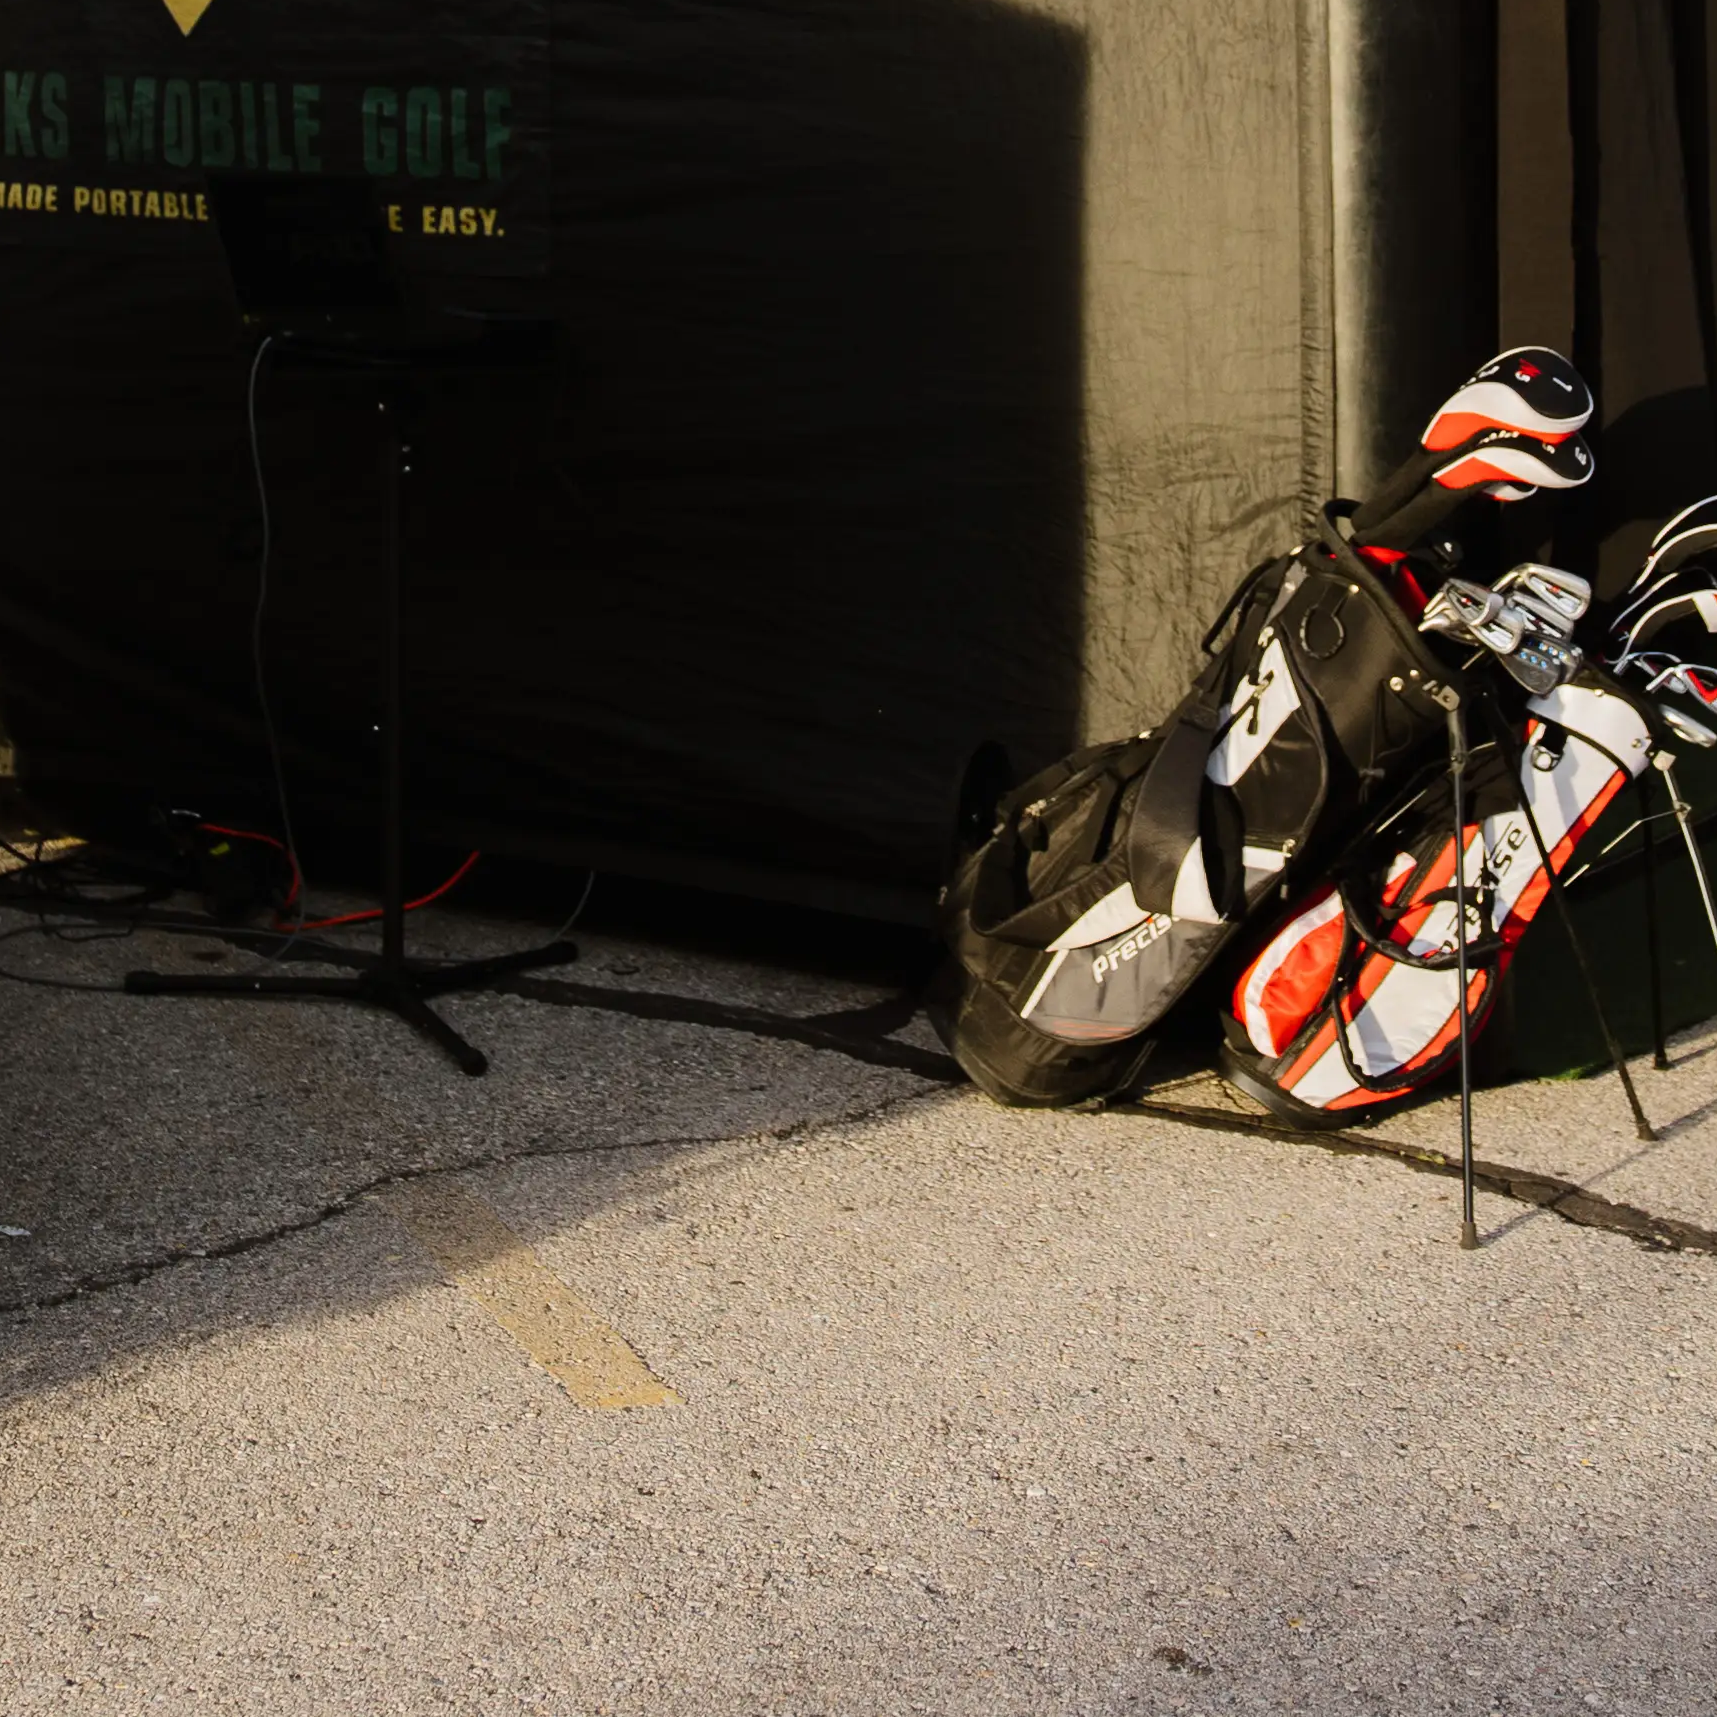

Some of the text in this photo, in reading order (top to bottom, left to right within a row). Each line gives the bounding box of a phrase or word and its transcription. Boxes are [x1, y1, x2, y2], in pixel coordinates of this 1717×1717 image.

[103, 74, 323, 173] MOBILE
[362, 85, 512, 180] GOLF
[73, 185, 209, 222] PORTABLE
[422, 205, 505, 238] EASY.
[1092, 913, 1180, 984] precis
